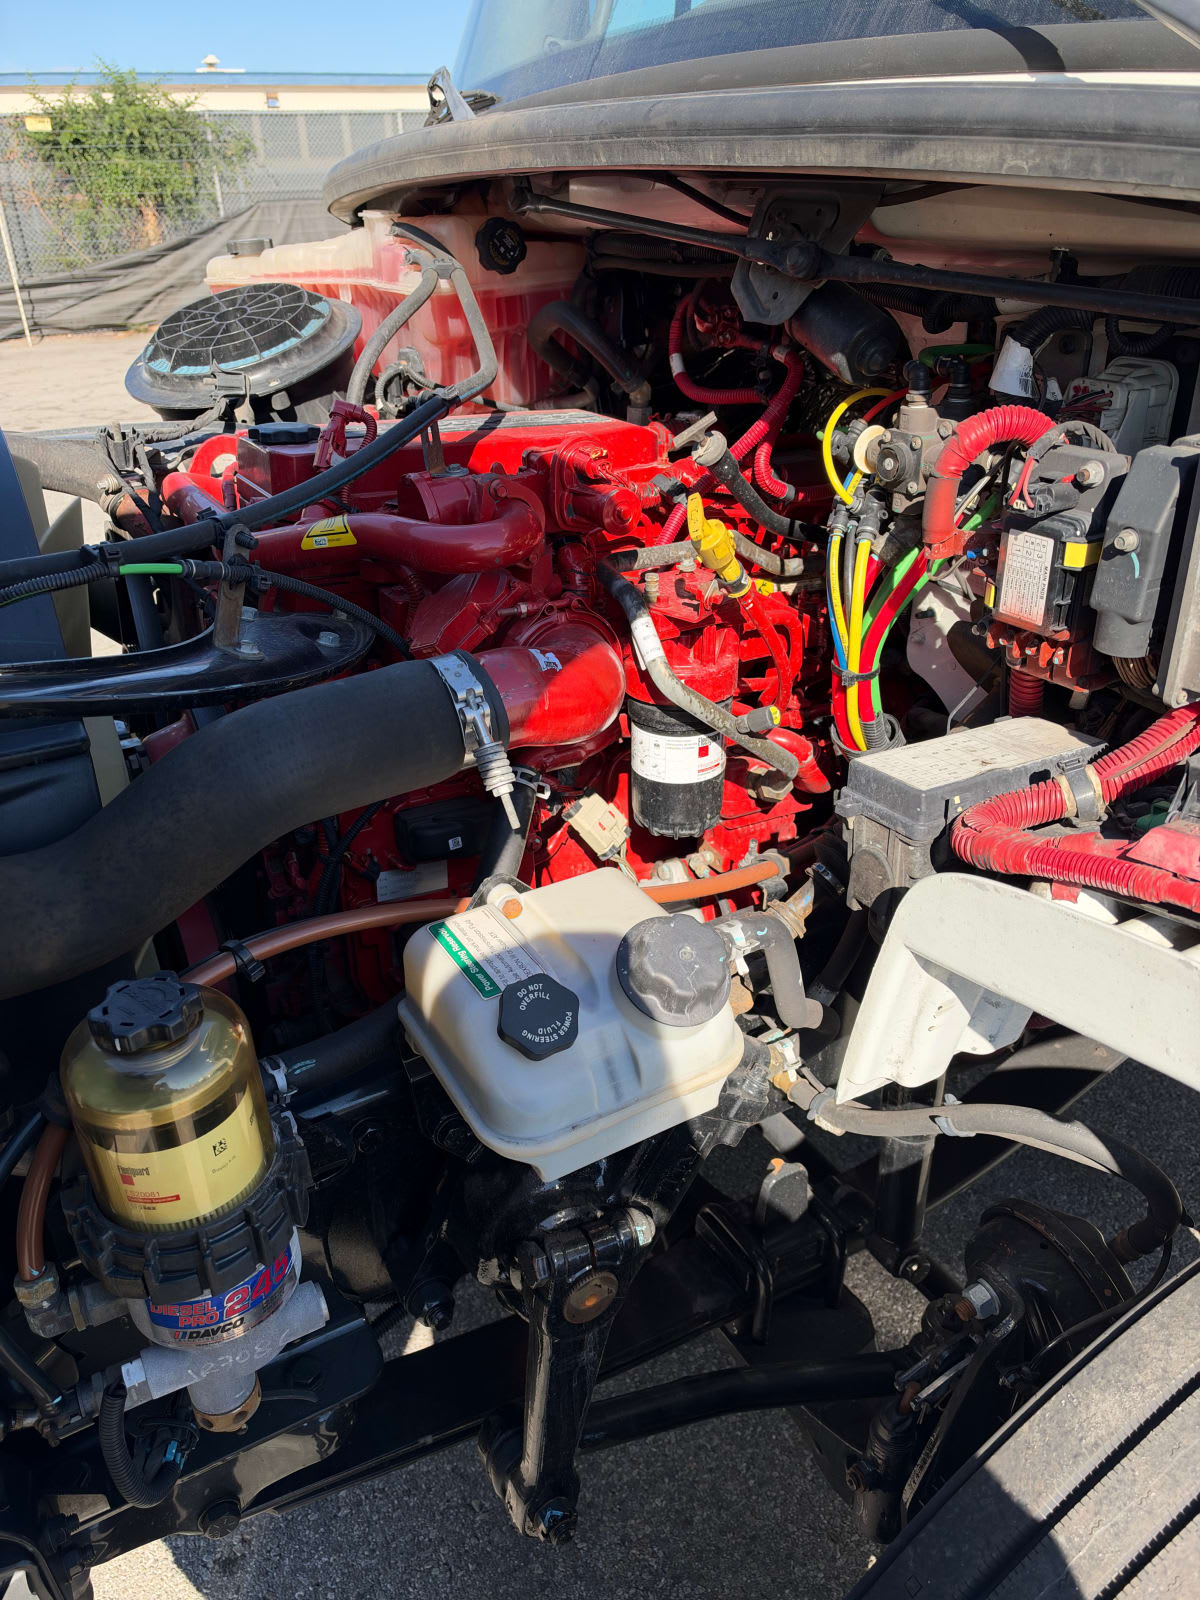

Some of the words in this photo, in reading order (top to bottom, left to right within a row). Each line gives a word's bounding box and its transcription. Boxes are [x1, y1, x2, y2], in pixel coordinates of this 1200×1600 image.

[438, 926, 461, 951] Reservoir
[457, 949, 479, 973] Steering
[476, 972, 493, 991] Power
[517, 988, 528, 998] DO
[528, 983, 543, 991] NOT
[519, 991, 550, 1011] OVERFILL
[537, 1020, 562, 1035] FLUID
[558, 1011, 573, 1036] POWER
[521, 1029, 559, 1043] STEERING
[224, 1250, 289, 1320] 245
[150, 1300, 217, 1317] DIESEL
[179, 1311, 219, 1328] PRO
[188, 1316, 245, 1340] DAVCO
